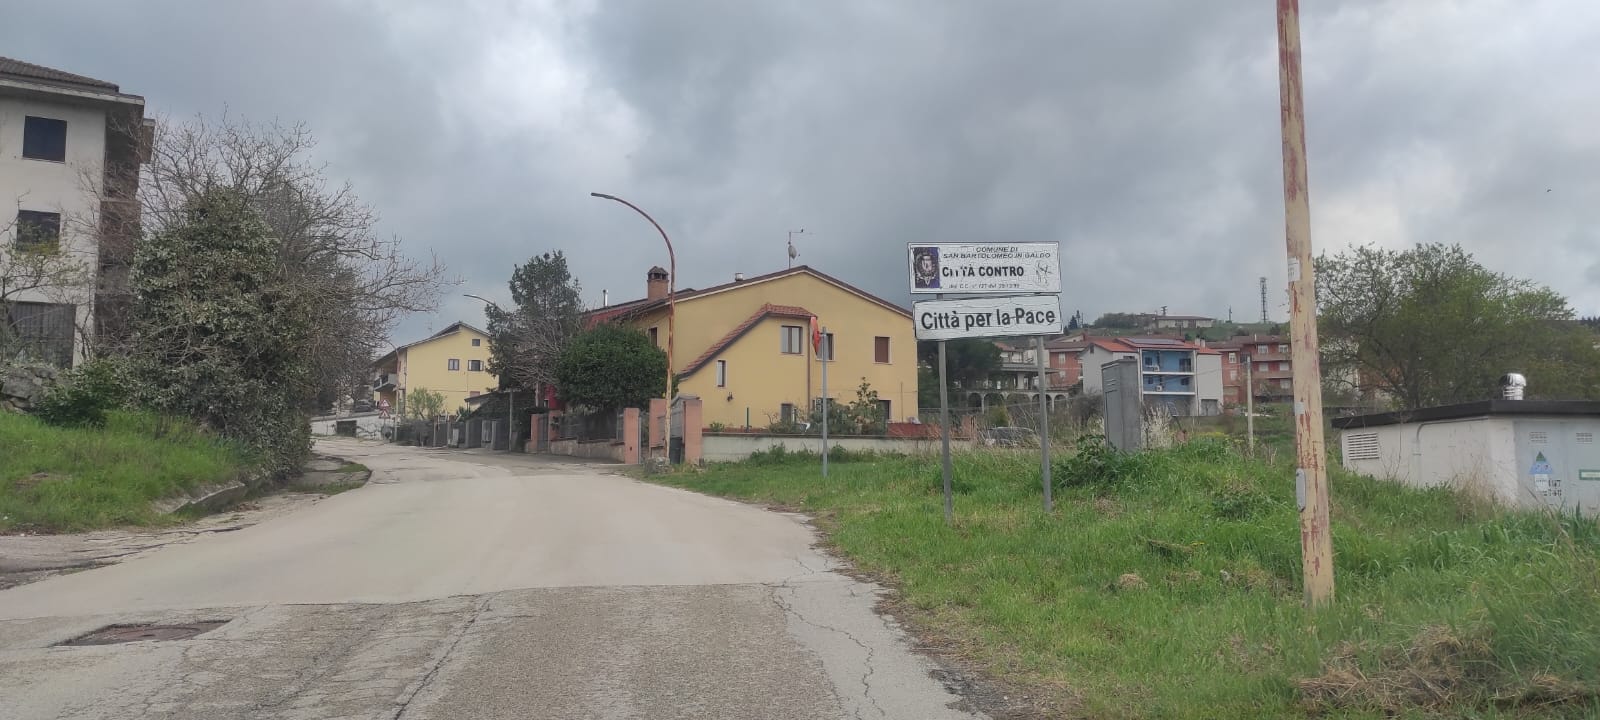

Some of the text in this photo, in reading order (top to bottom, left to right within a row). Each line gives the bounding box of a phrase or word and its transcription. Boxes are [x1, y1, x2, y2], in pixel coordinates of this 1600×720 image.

[978, 266, 1024, 277] CONTRO
[920, 307, 1055, 331] Città per la Pace
